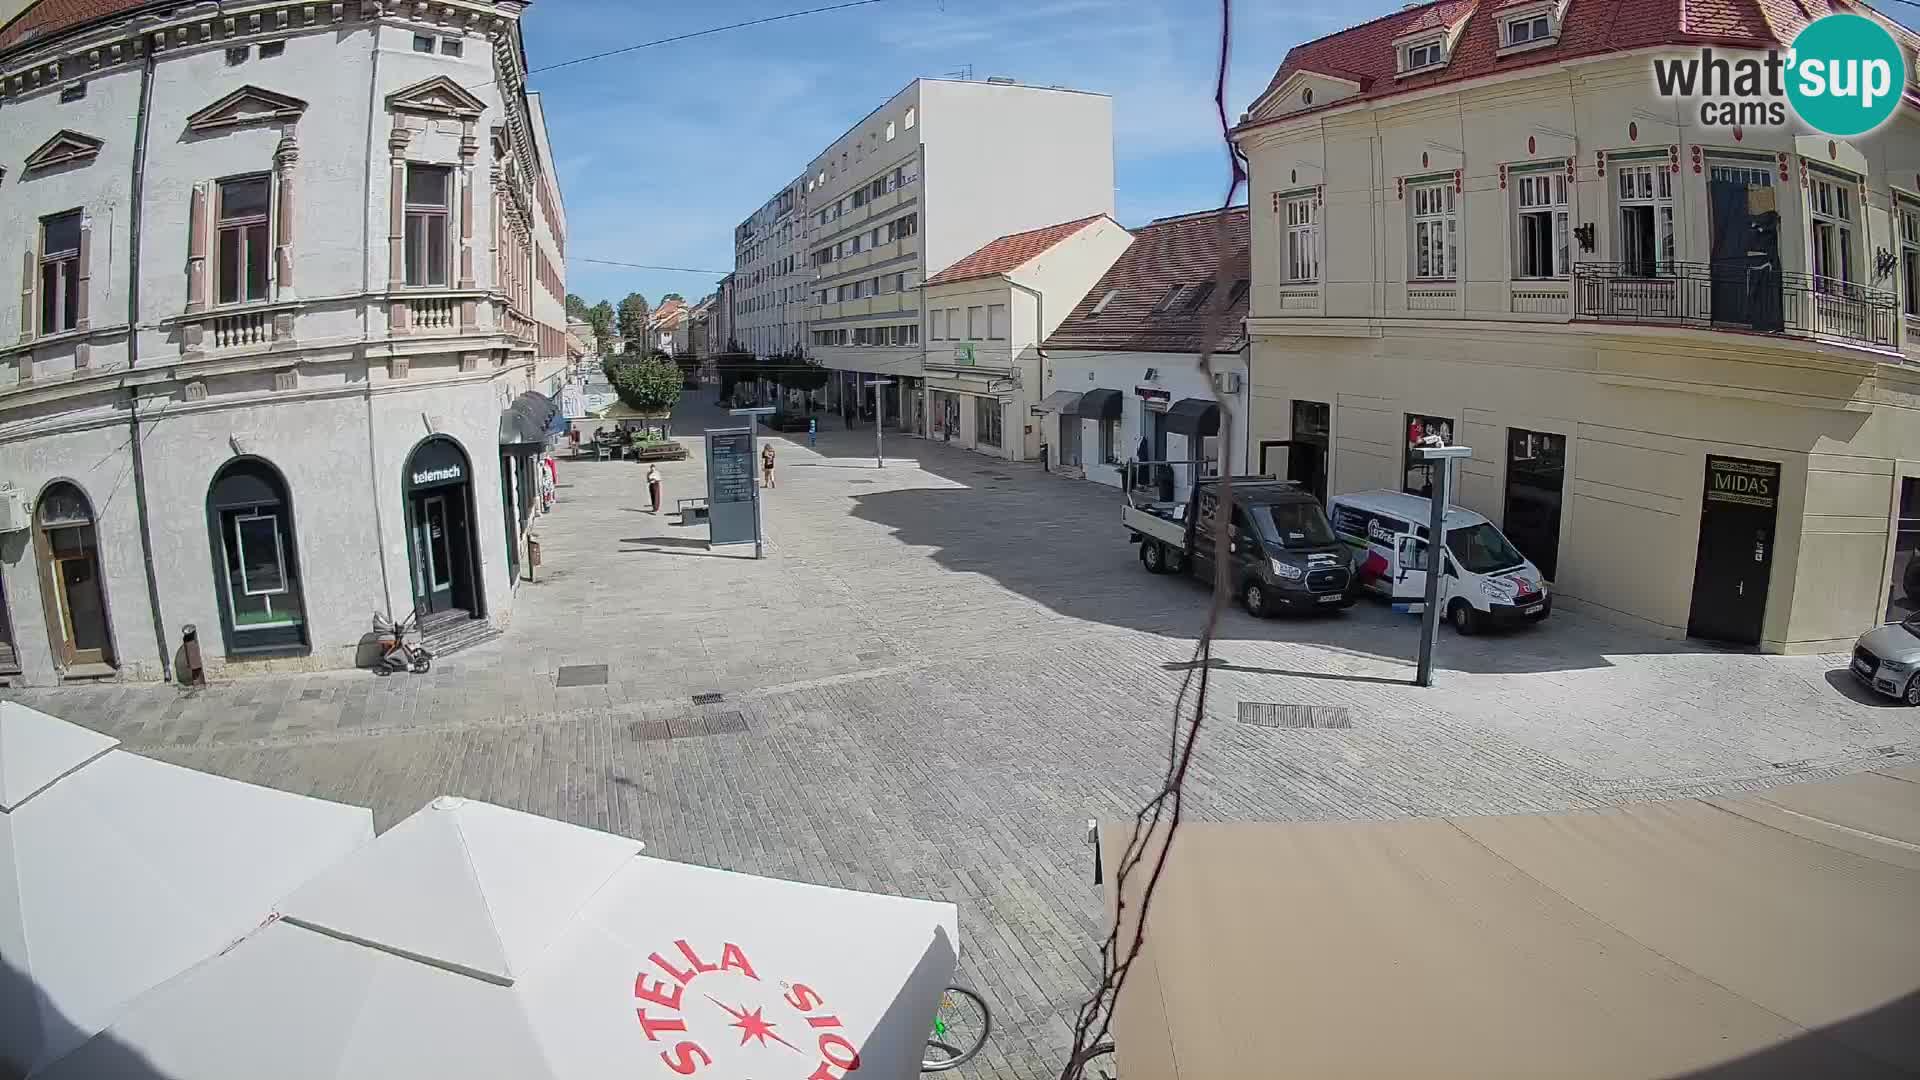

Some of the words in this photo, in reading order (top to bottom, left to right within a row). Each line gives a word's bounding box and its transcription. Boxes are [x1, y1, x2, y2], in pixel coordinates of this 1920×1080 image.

[413, 464, 460, 484] telemach
[1715, 473, 1769, 495] MIDAS
[634, 939, 761, 1075] STELLA
